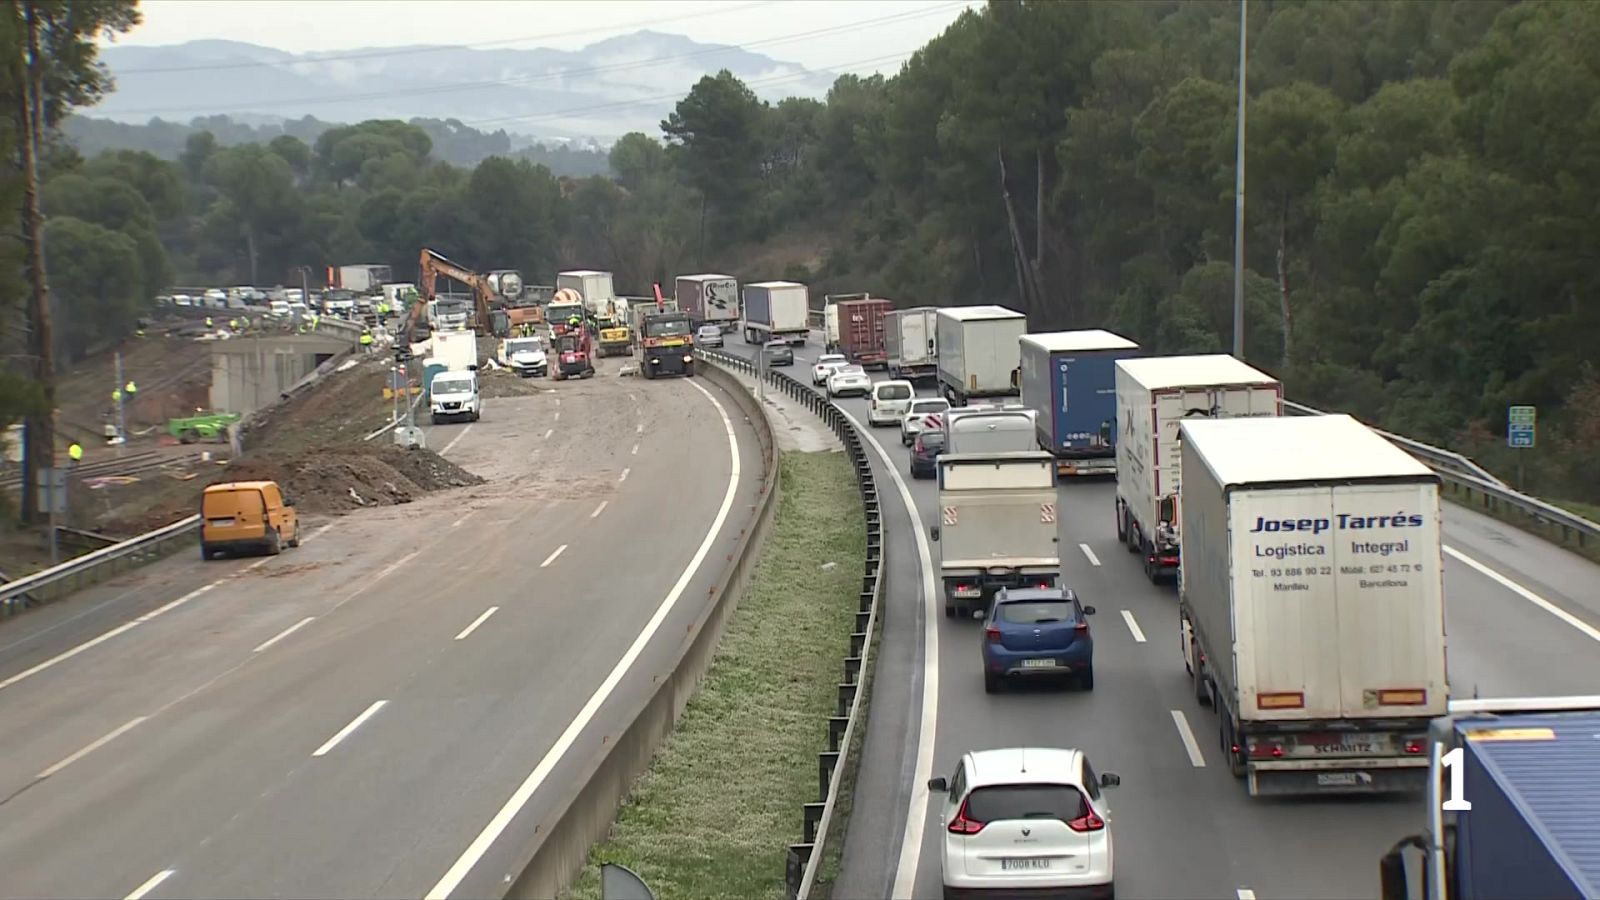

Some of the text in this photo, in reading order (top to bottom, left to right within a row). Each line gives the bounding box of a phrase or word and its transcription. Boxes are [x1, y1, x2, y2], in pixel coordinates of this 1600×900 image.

[1249, 510, 1424, 534] Josep Tarrés
[1255, 540, 1408, 560] Logistica Integral
[1252, 569, 1267, 578] Tel.
[1270, 568, 1282, 577] 93
[1319, 566, 1332, 575] 22
[1359, 579, 1408, 589] Barcelona
[1312, 743, 1372, 754] SCHMITZ
